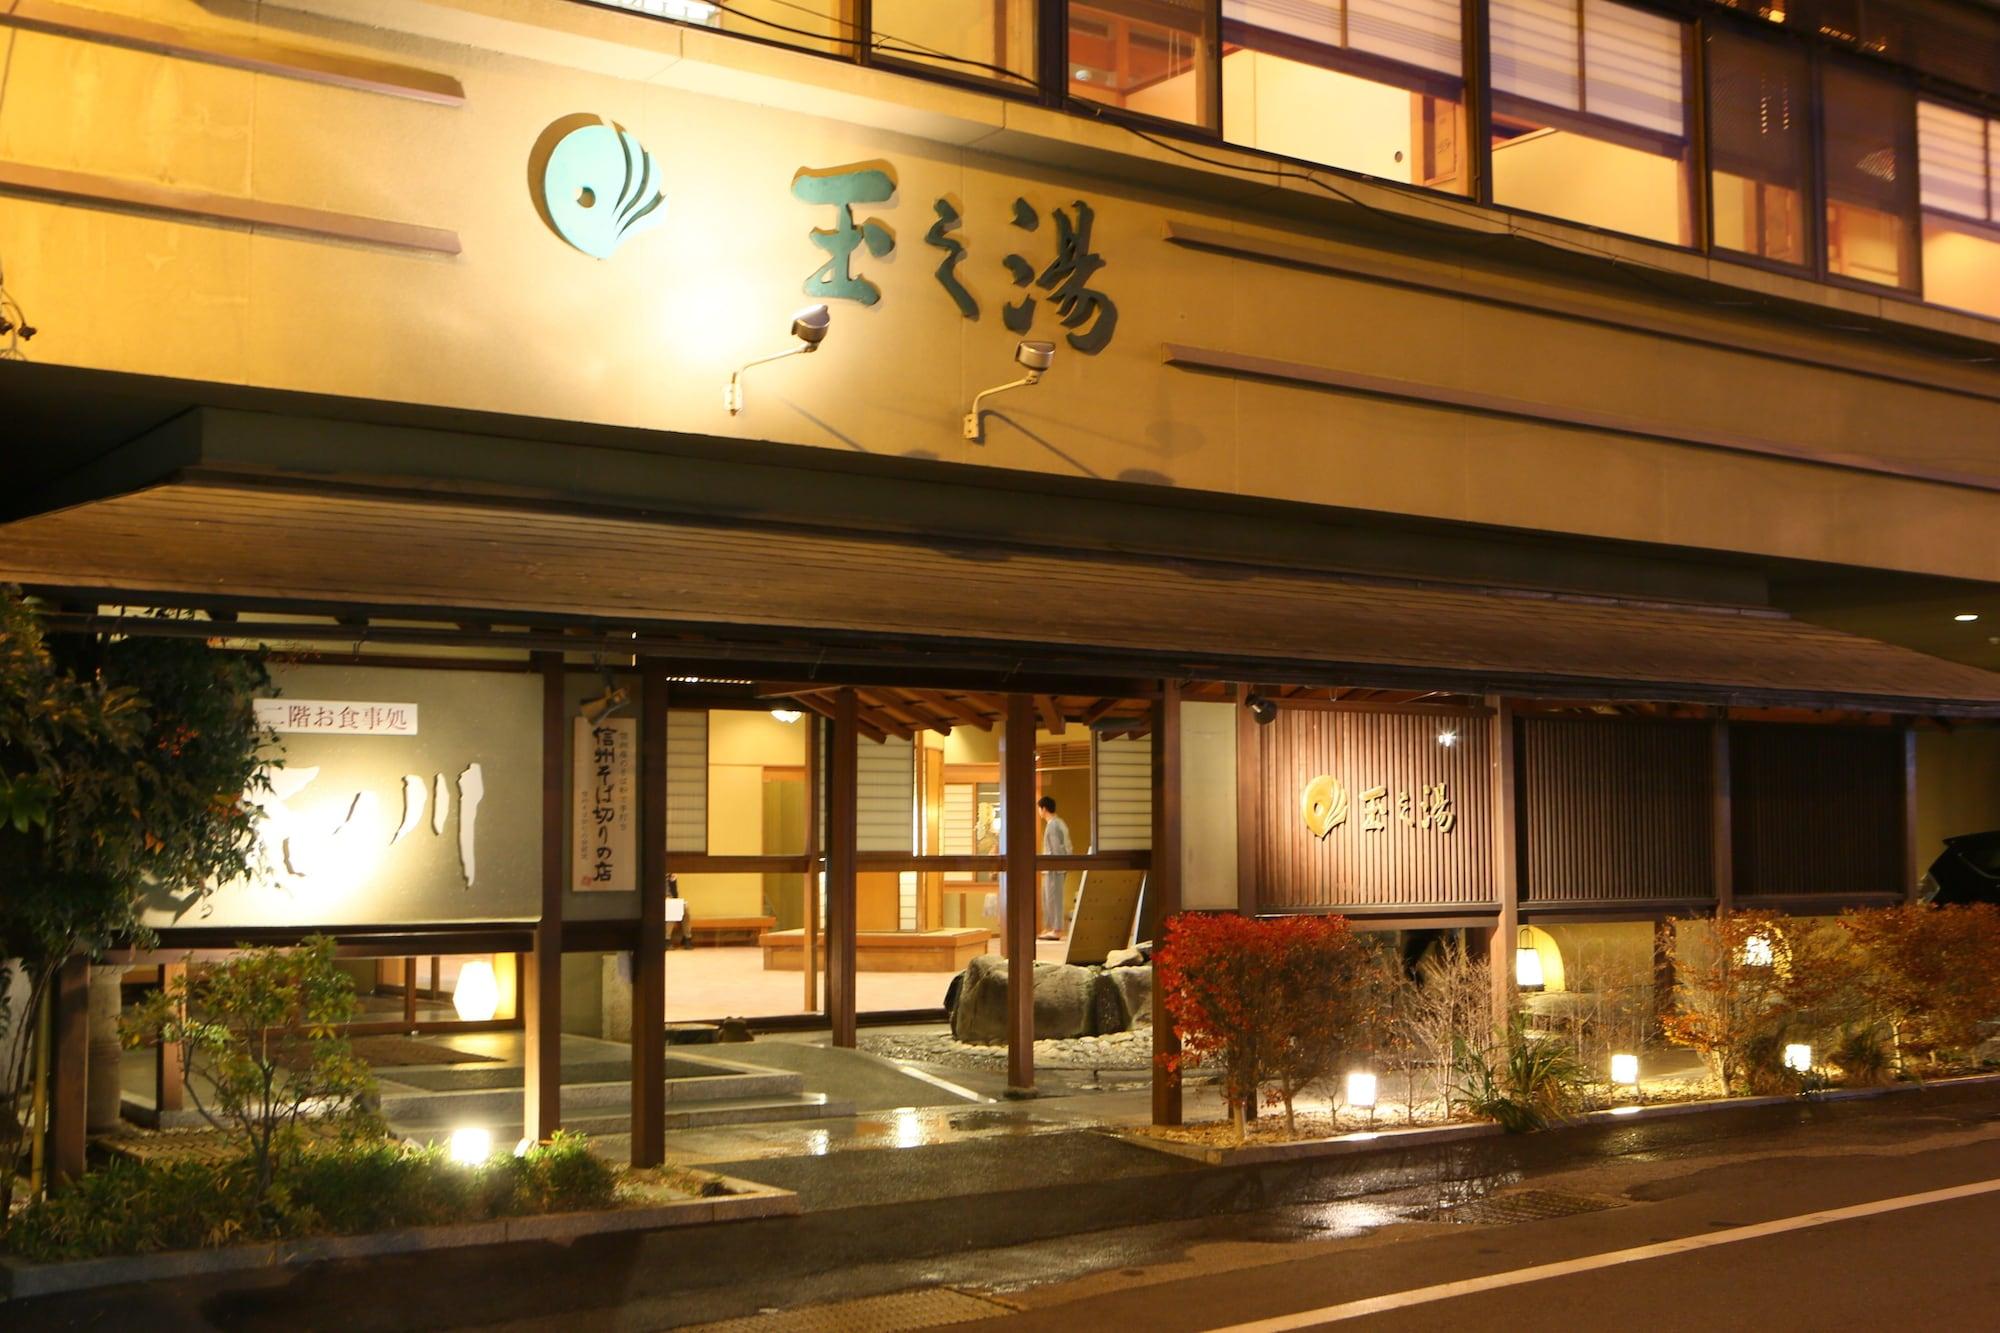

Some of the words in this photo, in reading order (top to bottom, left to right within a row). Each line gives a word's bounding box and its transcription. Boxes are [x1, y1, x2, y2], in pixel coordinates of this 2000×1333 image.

[256, 704, 409, 731] 二階お食事処
[592, 726, 618, 883] 信州そば切りの店
